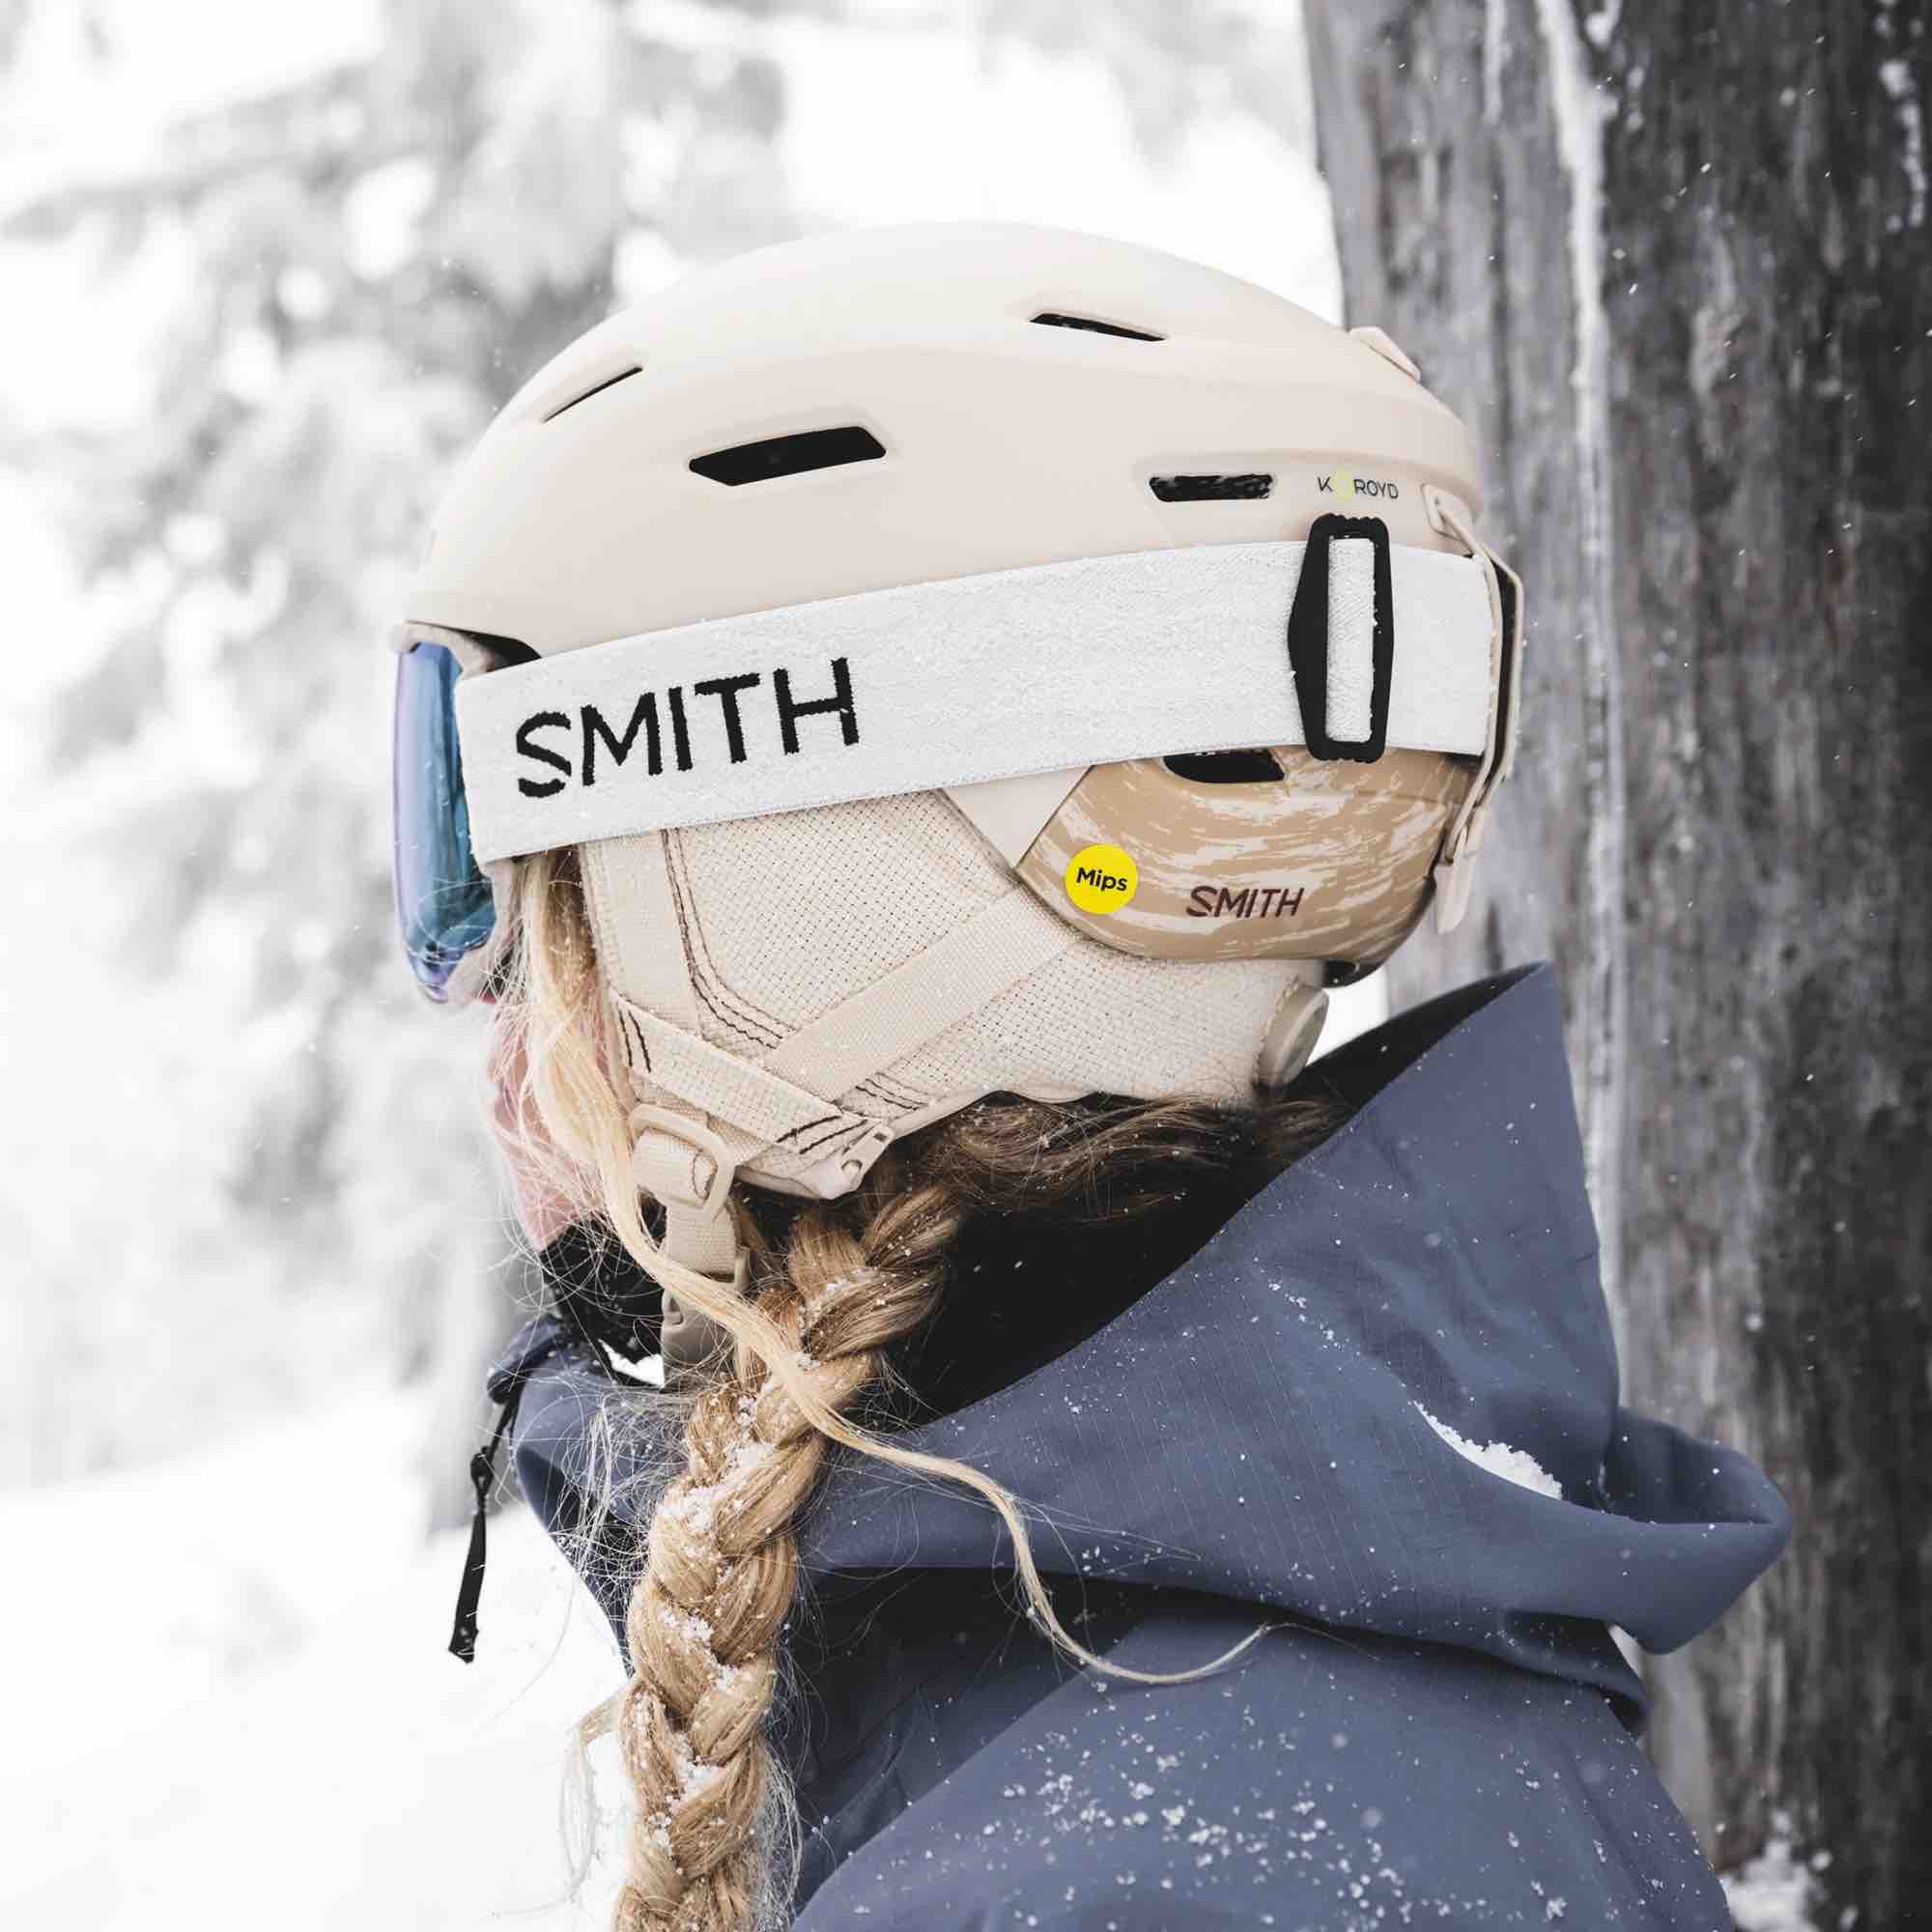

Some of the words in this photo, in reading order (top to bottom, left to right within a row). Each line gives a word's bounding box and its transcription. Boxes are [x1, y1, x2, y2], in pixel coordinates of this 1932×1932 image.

[516, 657, 860, 799] SMITH
[1076, 867, 1128, 892] Mips
[1186, 886, 1305, 918] SMITH
